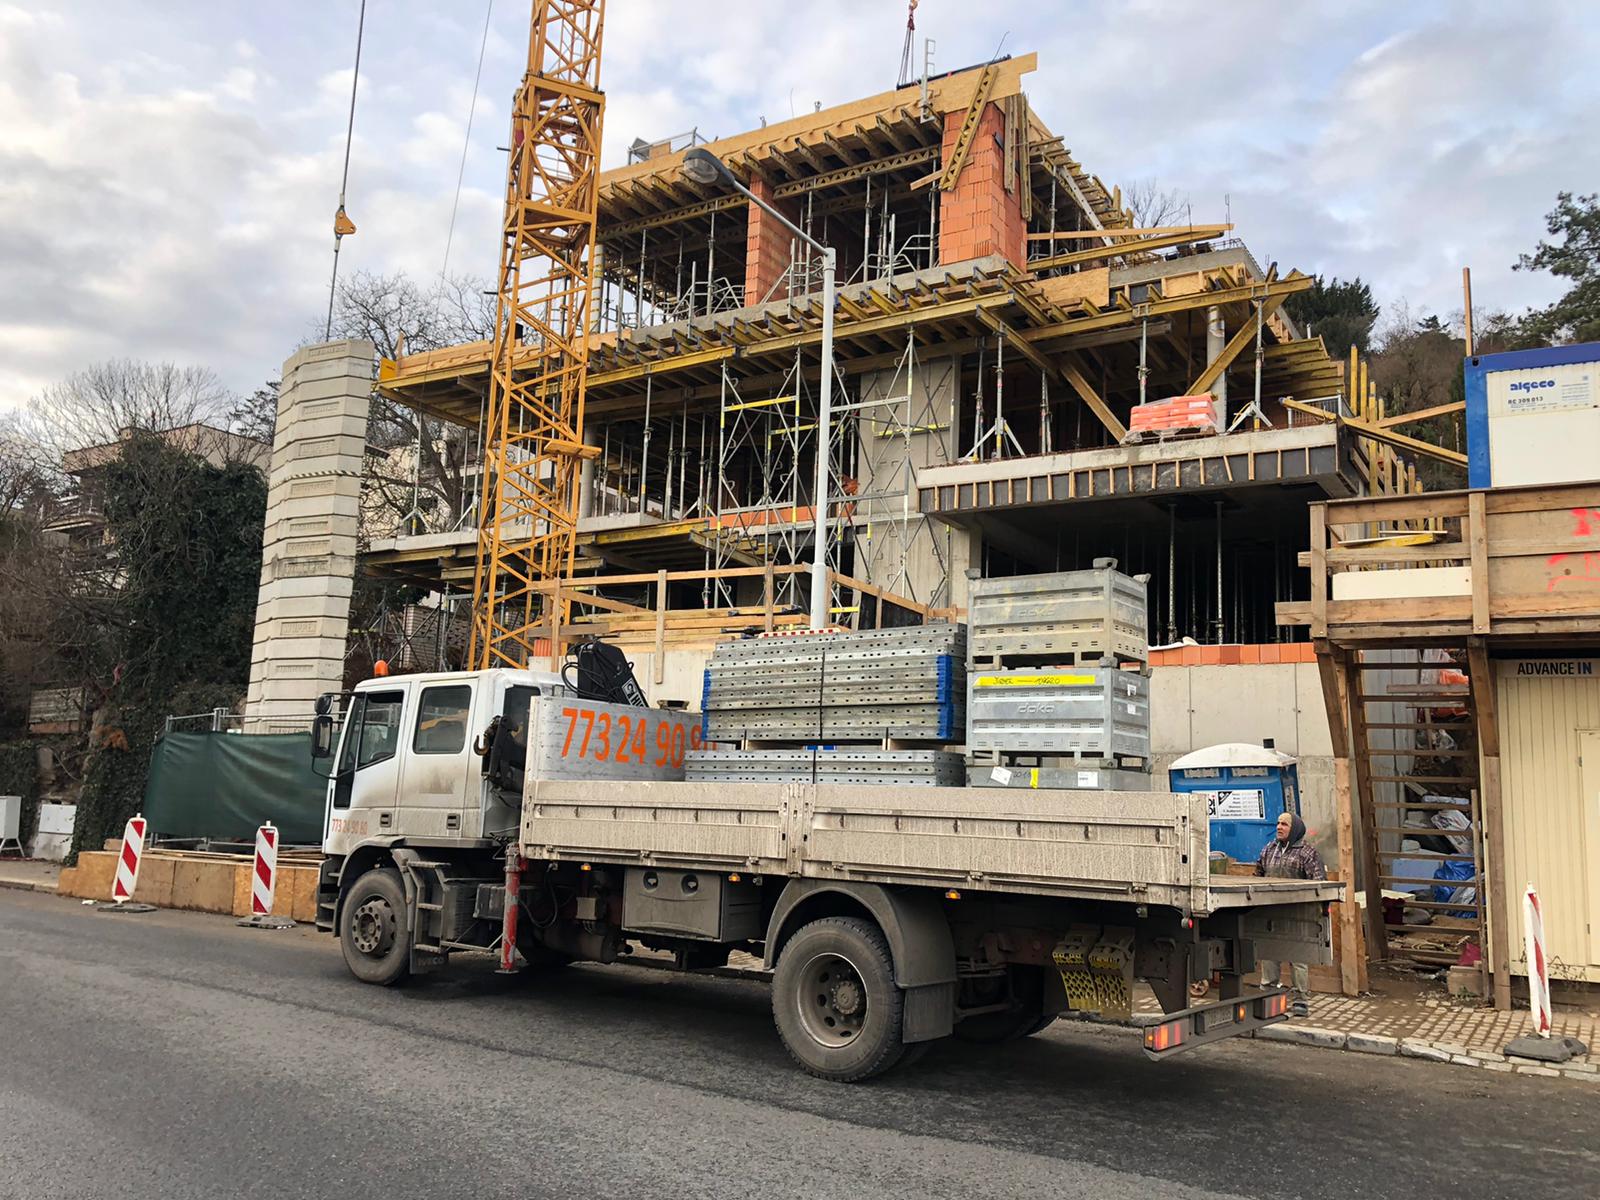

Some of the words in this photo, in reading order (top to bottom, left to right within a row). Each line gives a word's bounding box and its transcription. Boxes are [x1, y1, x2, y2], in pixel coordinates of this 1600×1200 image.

[1510, 380, 1555, 393] algeco
[1517, 662, 1574, 675] ADVANCE
[1578, 662, 1592, 675] IN
[1018, 702, 1055, 714] doka
[655, 720, 686, 769] 90
